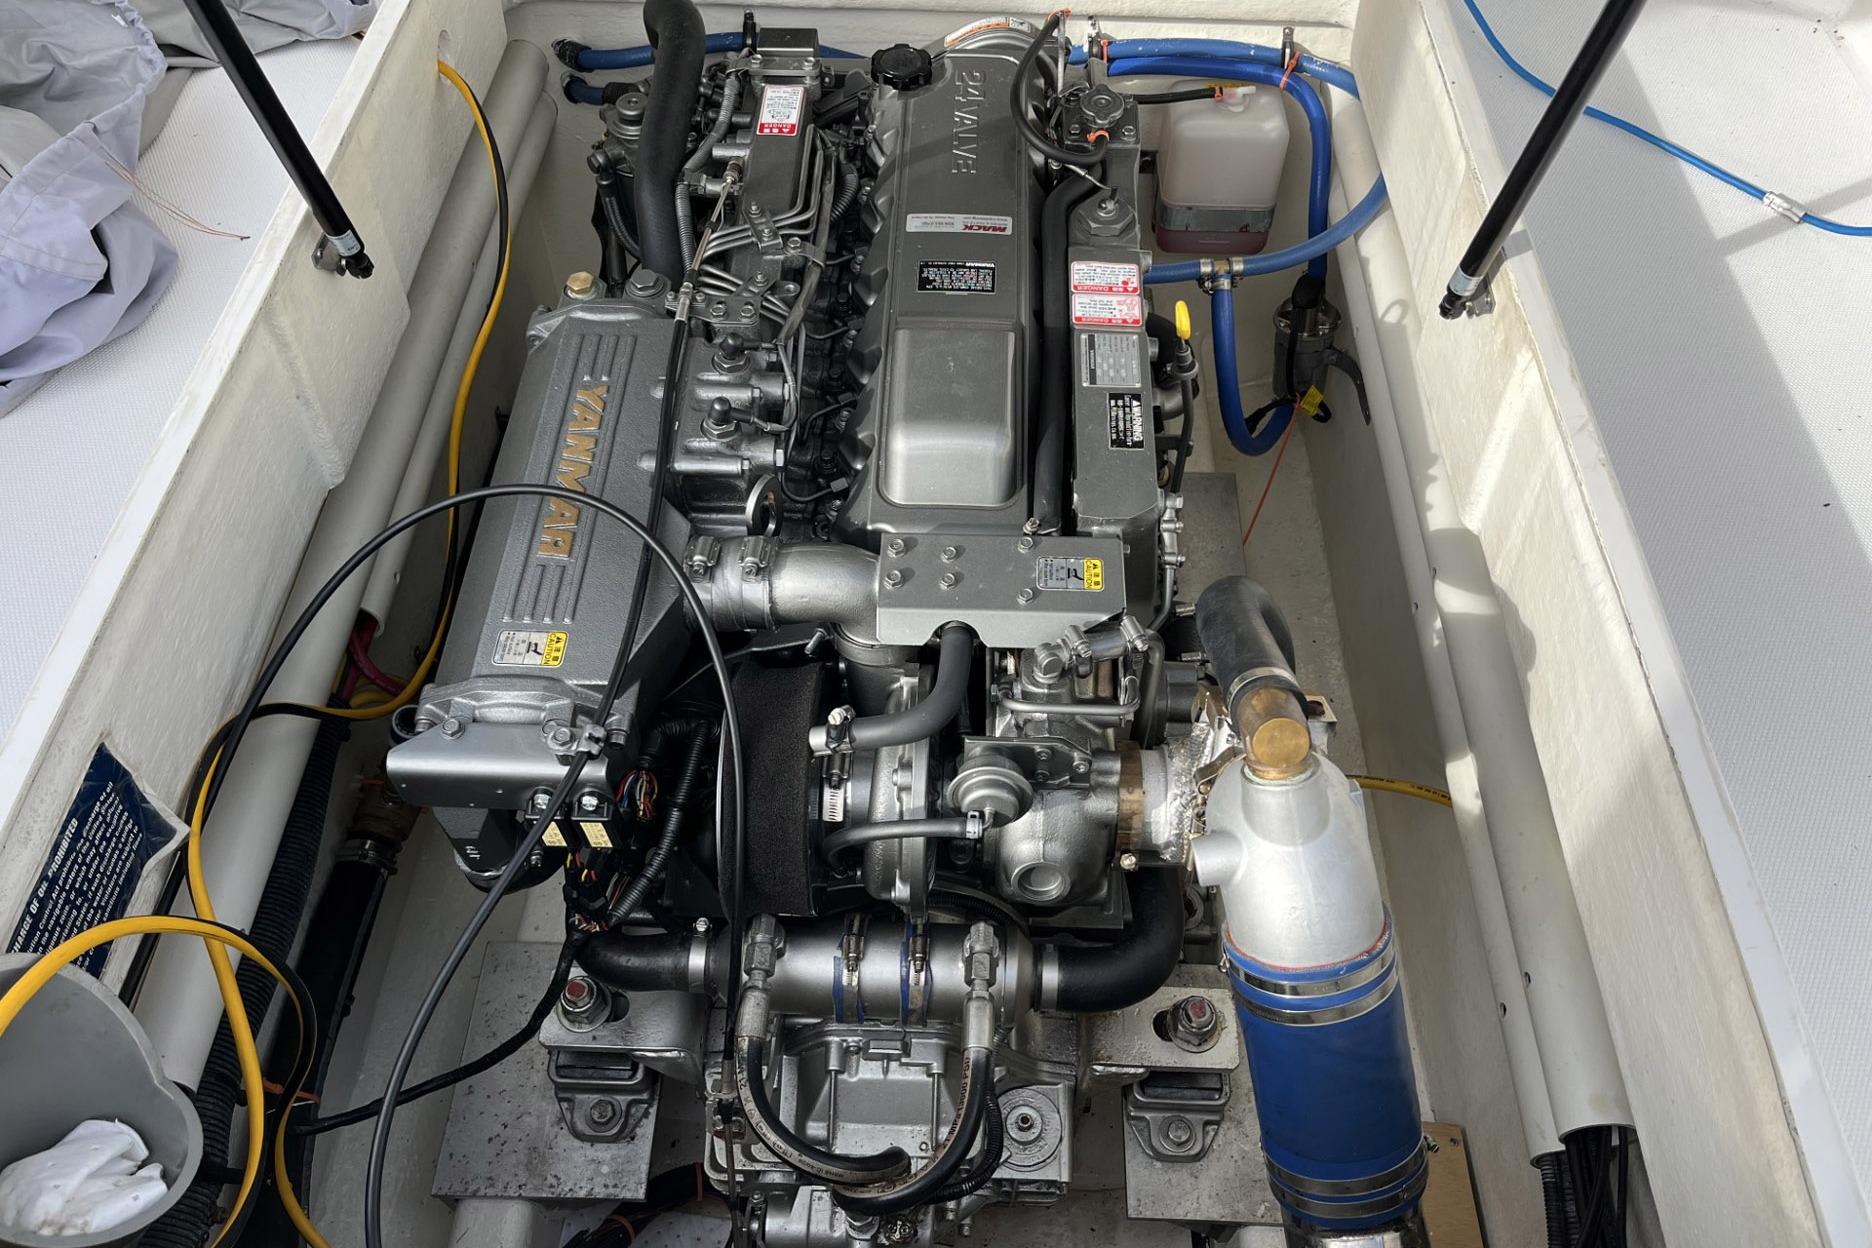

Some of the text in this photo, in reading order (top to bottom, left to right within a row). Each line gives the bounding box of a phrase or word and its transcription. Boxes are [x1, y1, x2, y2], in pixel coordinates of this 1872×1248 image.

[961, 224, 1008, 233] MACK
[1132, 406, 1144, 442] WARNING
[537, 384, 609, 560] YANMAR
[1085, 560, 1093, 590] CAUTION
[542, 632, 556, 666] CAUTION
[39, 900, 54, 930] Control
[52, 885, 60, 900] Act
[106, 781, 114, 793] oil
[48, 818, 78, 878] PROHIBITED
[75, 865, 87, 888] which
[86, 846, 96, 864] may
[94, 823, 106, 846] affect
[88, 856, 100, 879] under
[91, 873, 102, 892] such
[100, 837, 117, 873] discharge
[118, 852, 136, 885] including
[121, 833, 135, 860] subject
[41, 931, 49, 945] the
[48, 891, 67, 930] navigable
[65, 864, 79, 890] waters
[81, 841, 90, 854] the
[88, 815, 103, 840] United
[86, 908, 94, 922] the
[93, 886, 104, 907] water
[106, 850, 120, 876] causes
